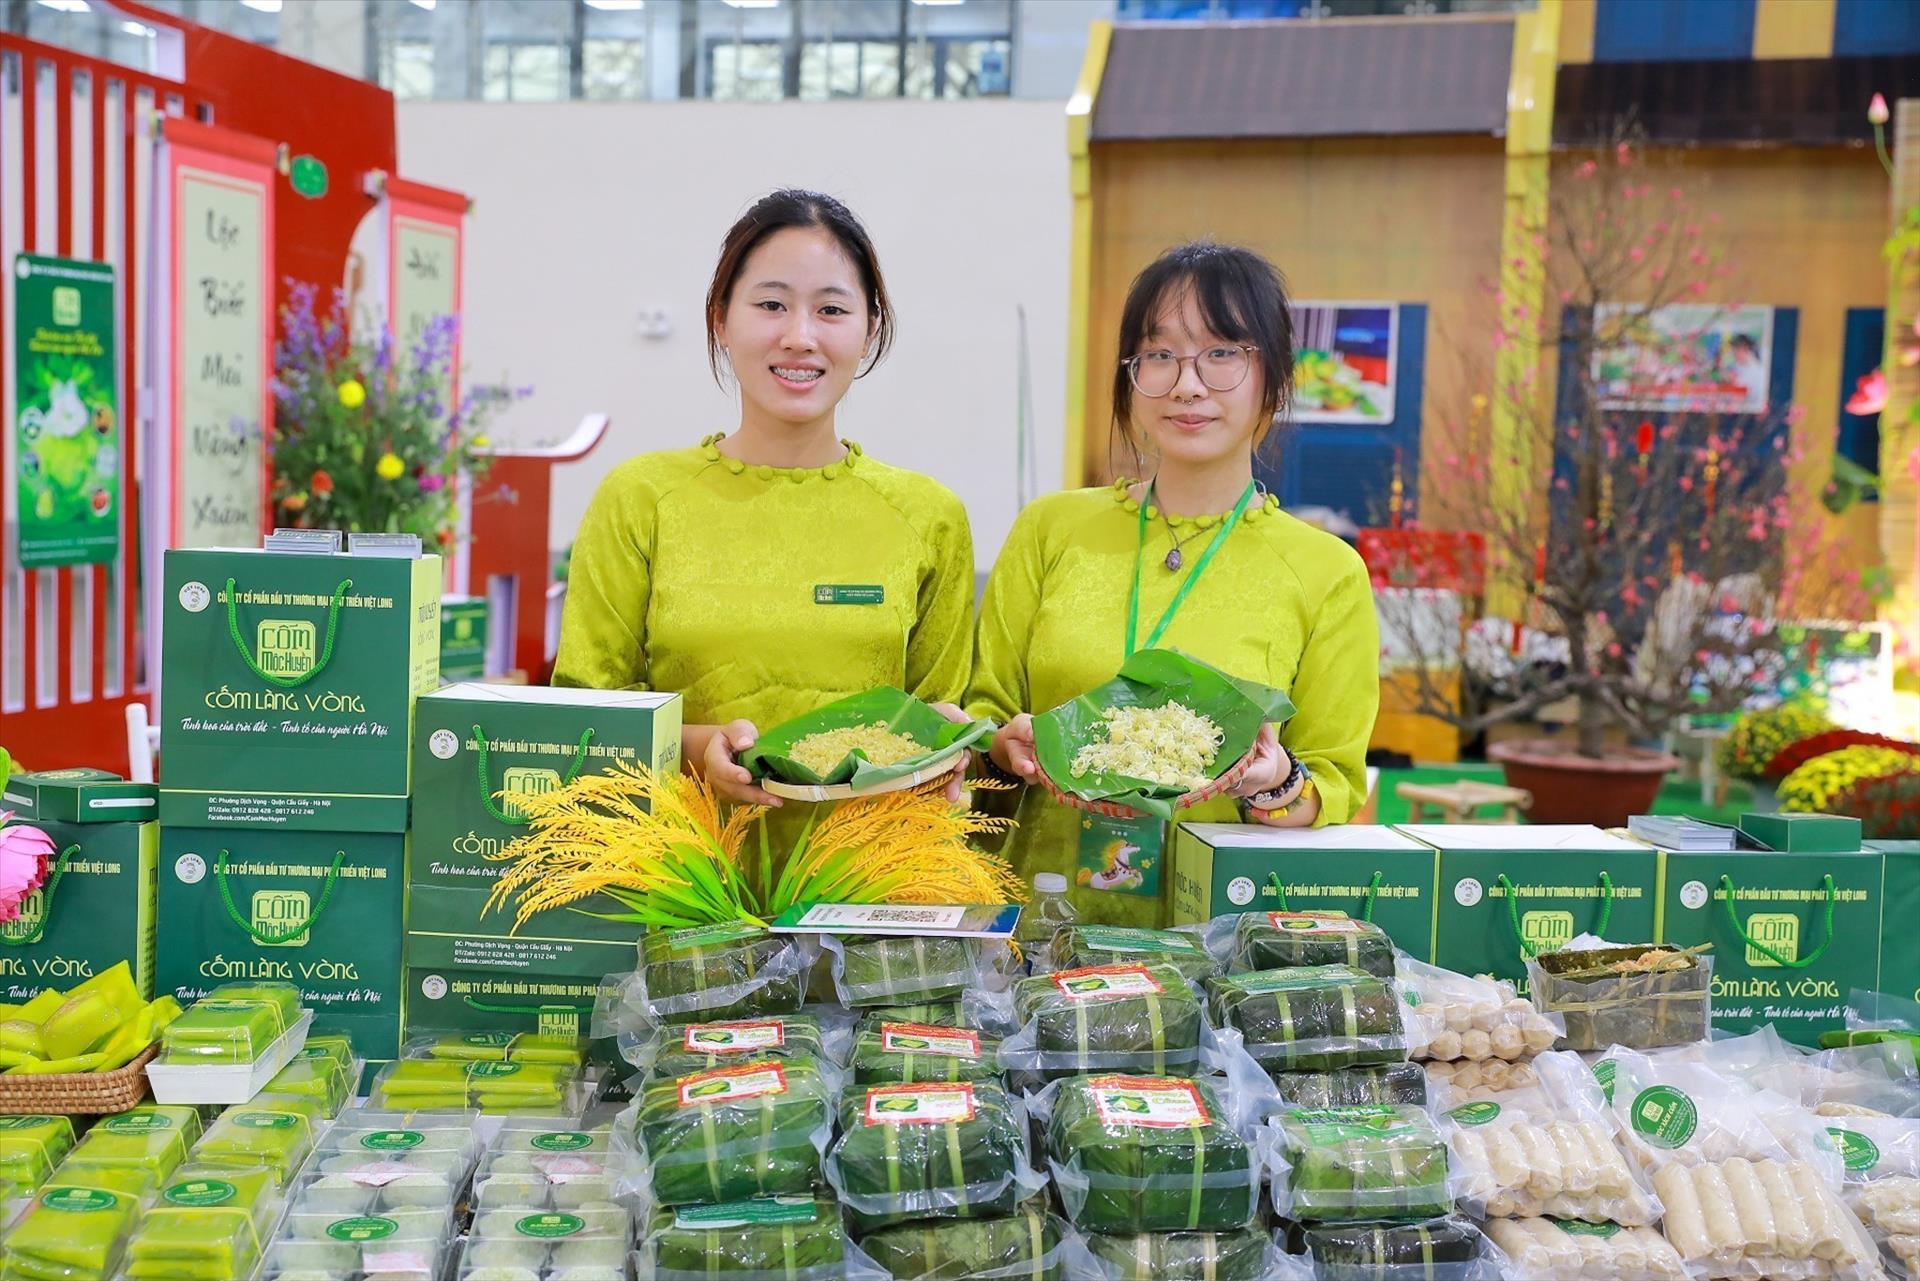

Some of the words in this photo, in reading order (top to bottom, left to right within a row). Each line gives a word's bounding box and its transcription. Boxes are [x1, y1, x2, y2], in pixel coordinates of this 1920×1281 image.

[377, 597, 393, 609] LONG
[255, 688, 299, 711] LÀNG
[304, 690, 366, 713] VÒNG
[352, 721, 368, 735] Hà
[370, 722, 389, 738] Nội
[619, 747, 635, 758] LONG
[105, 863, 121, 874] LONG
[371, 867, 387, 878] LONG
[32, 956, 93, 977] VÒNG
[249, 957, 293, 979] LÀNG
[298, 959, 359, 980] VÒNG
[1711, 974, 1740, 997] ỐM
[1742, 977, 1781, 998] LÀNG
[1785, 977, 1840, 998] VÒNG
[346, 988, 362, 1002] Hà
[363, 989, 382, 1003] Nội
